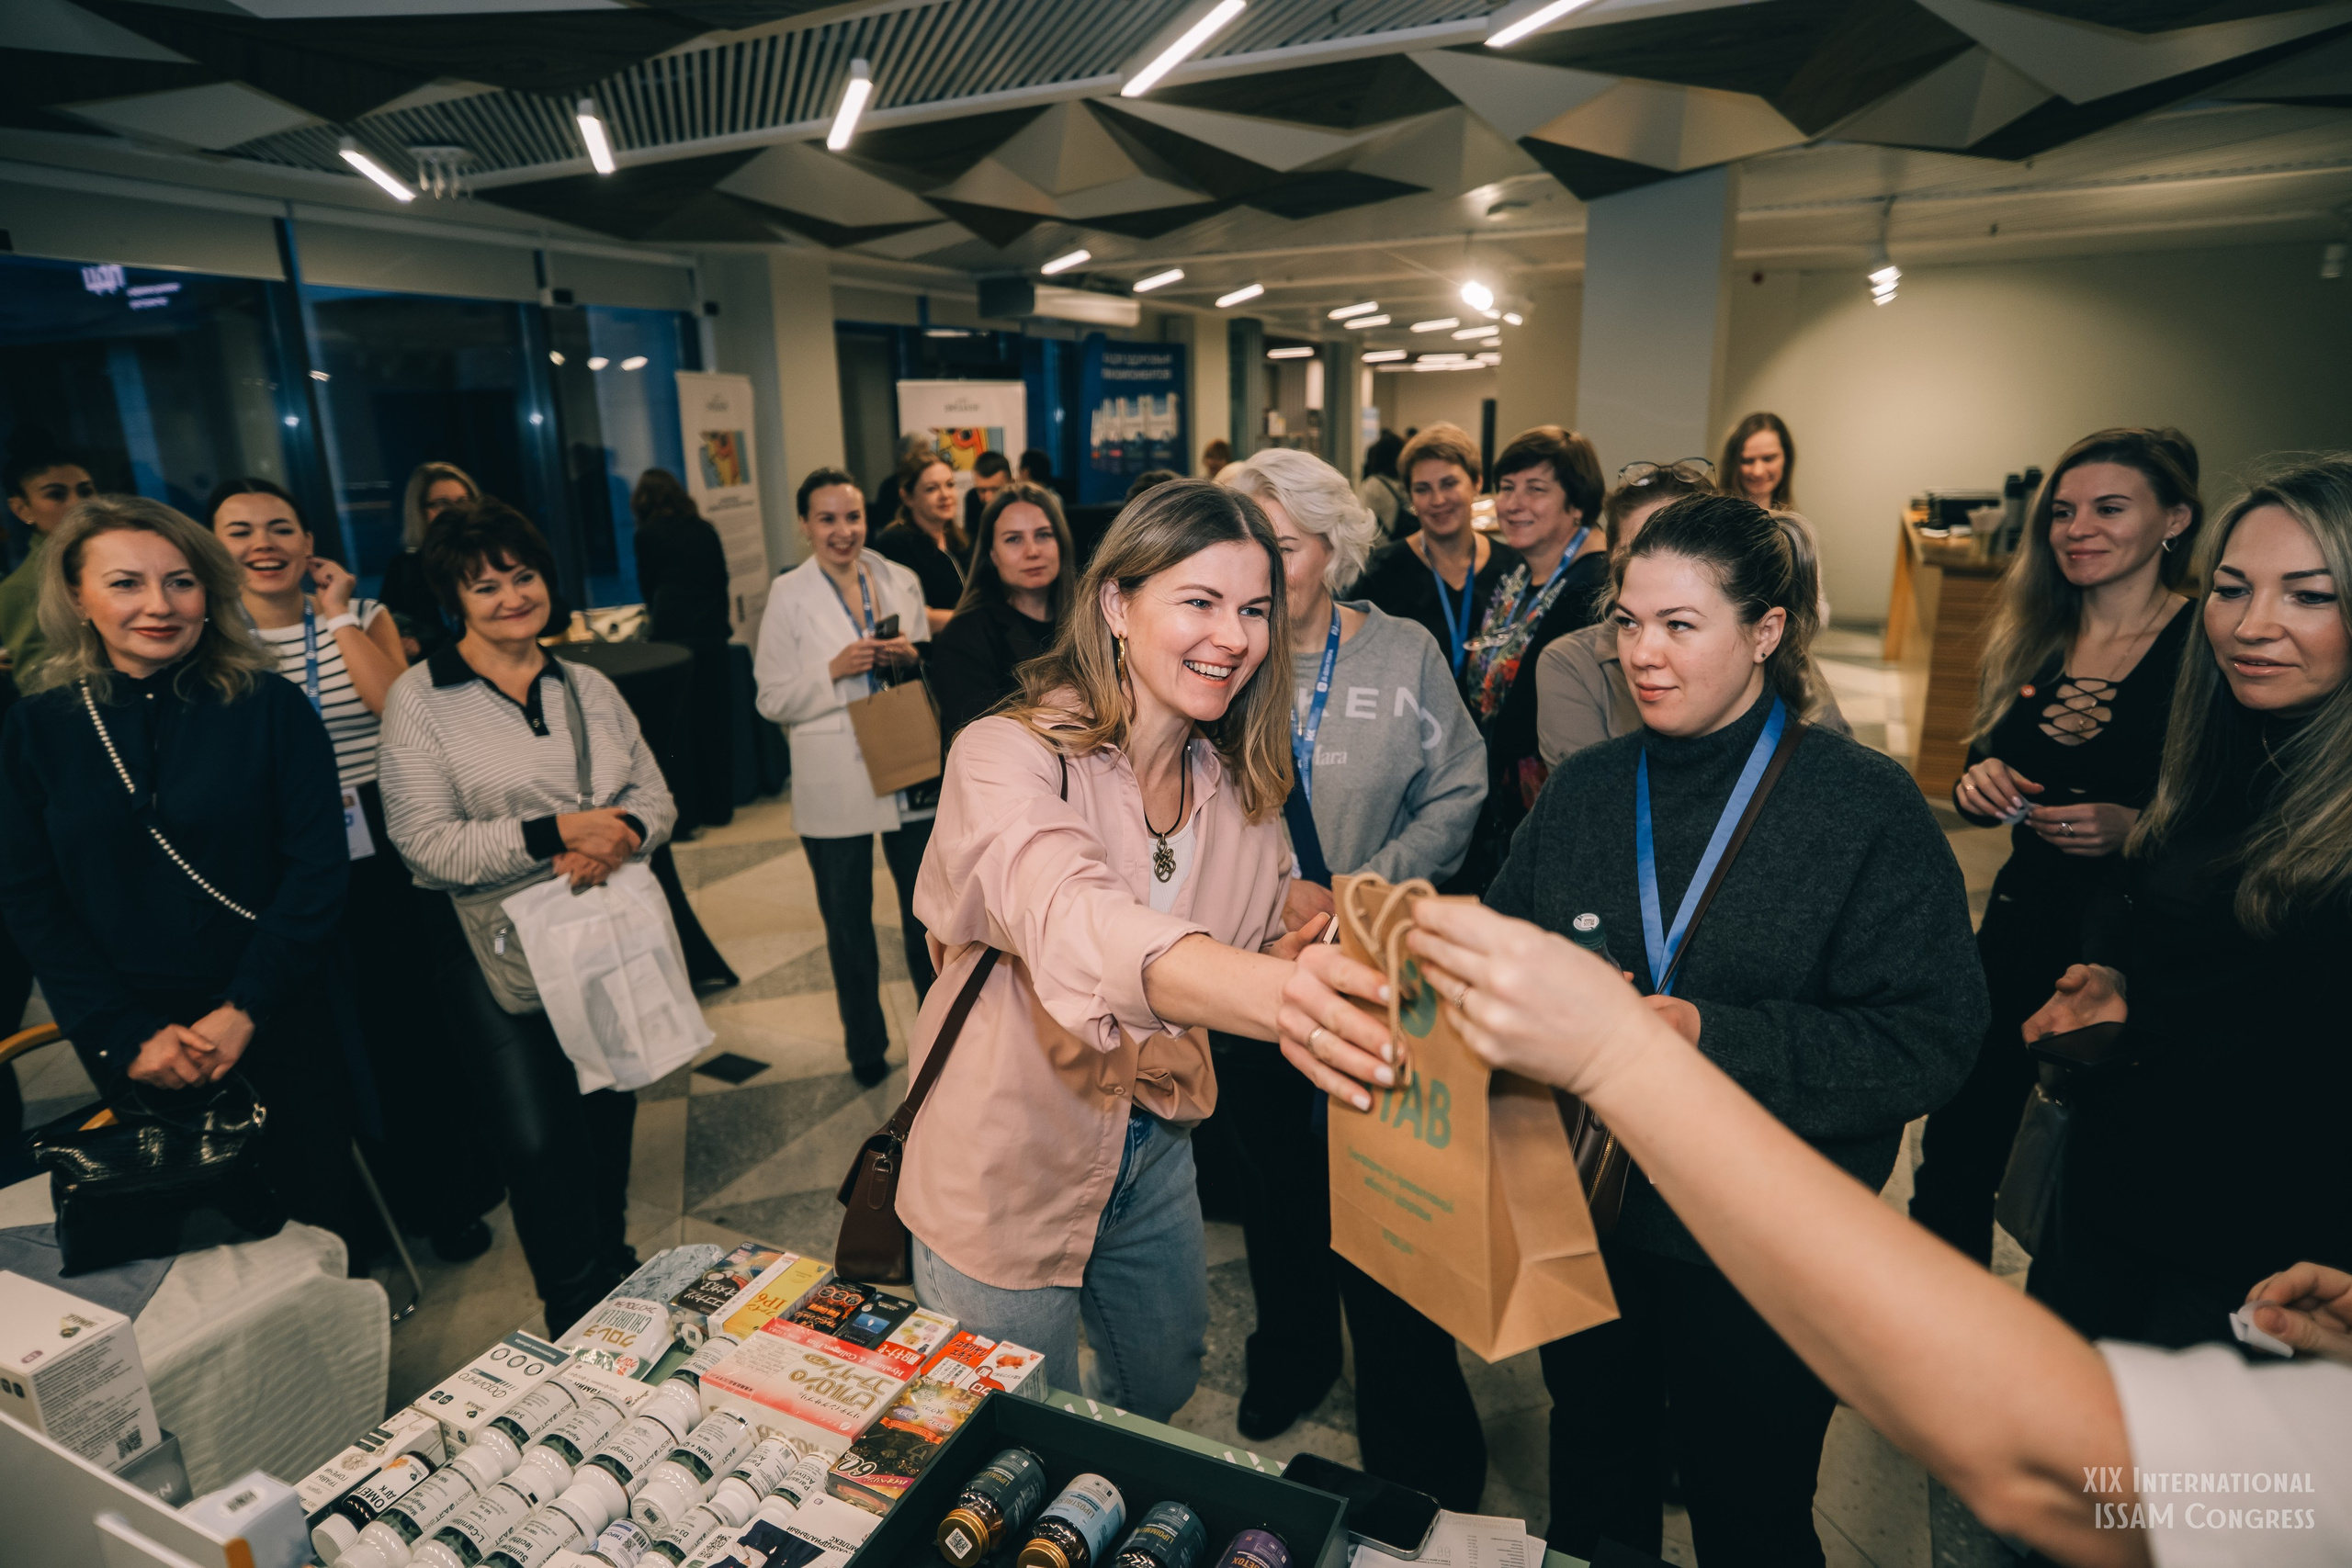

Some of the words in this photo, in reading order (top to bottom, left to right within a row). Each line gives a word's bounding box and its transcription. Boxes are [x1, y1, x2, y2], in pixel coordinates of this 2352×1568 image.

[683, 1291, 725, 1308] ココナッツ
[754, 1292, 786, 1310] IP6
[596, 1309, 650, 1334] CHLORELLA
[582, 1325, 636, 1348] クロレラ
[805, 1337, 822, 1348] Plus
[821, 1341, 857, 1360] Collagen
[950, 1350, 972, 1361] エキス
[865, 1359, 903, 1379] Hyaluron
[696, 1446, 714, 1461] NMN
[314, 1473, 338, 1487] ТРАВЫ
[323, 1466, 348, 1482] ГОРЕЧИ
[379, 1484, 396, 1499] ДГК
